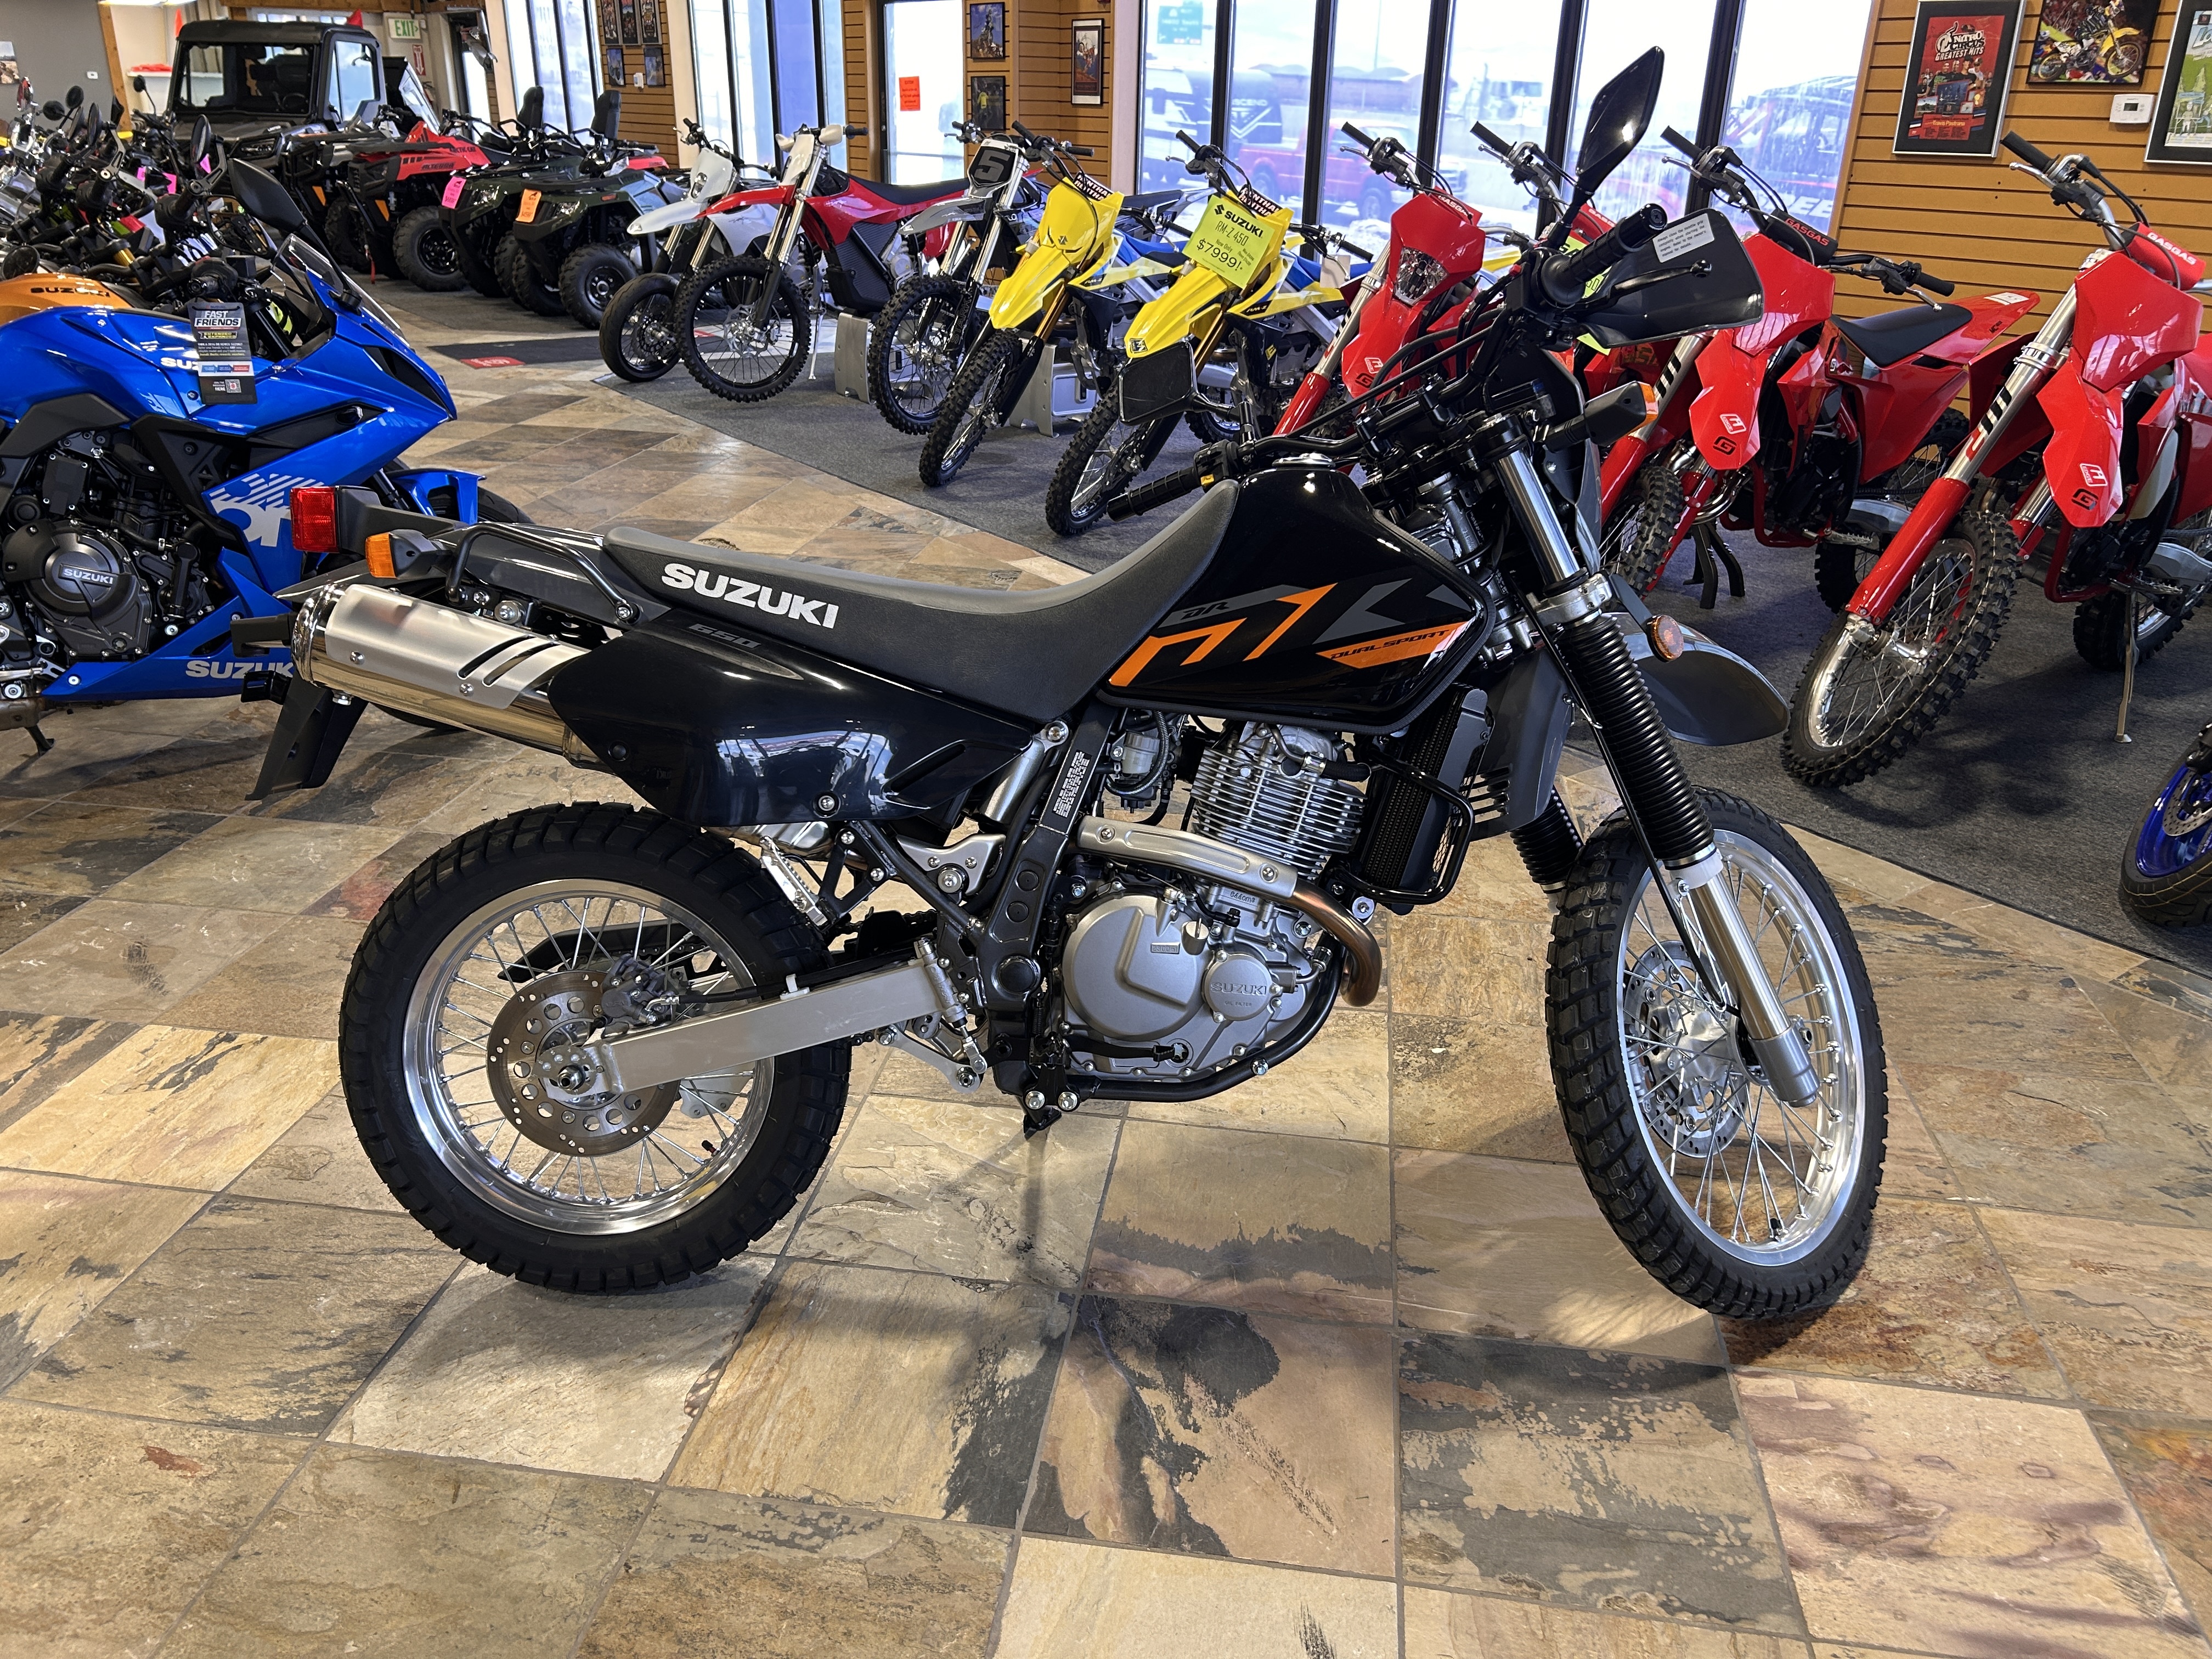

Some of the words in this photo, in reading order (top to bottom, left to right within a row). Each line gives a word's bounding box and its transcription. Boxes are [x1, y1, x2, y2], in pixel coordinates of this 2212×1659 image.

[394, 20, 415, 37] EXIT
[1954, 30, 1984, 43] NITRO
[1935, 49, 1967, 61] GREATEST
[1968, 47, 1984, 56] HITS
[1950, 38, 1985, 51] CIRCUS
[974, 149, 1011, 182] 5
[1225, 211, 1263, 238] SUZUKI
[1588, 208, 1615, 228] GASG
[1215, 221, 1234, 238] RM-Z
[1234, 231, 1249, 247] 450
[1785, 218, 1830, 246] GASGAS
[1215, 239, 1224, 247] Now
[1223, 243, 1233, 253] Only
[2147, 232, 2197, 265] GASGAS
[950, 298, 972, 345] STARK
[64, 568, 113, 584] SUZUKI
[661, 562, 839, 629] SUZUKI
[688, 623, 761, 648] 650
[1210, 982, 1267, 995] SUZUKI
